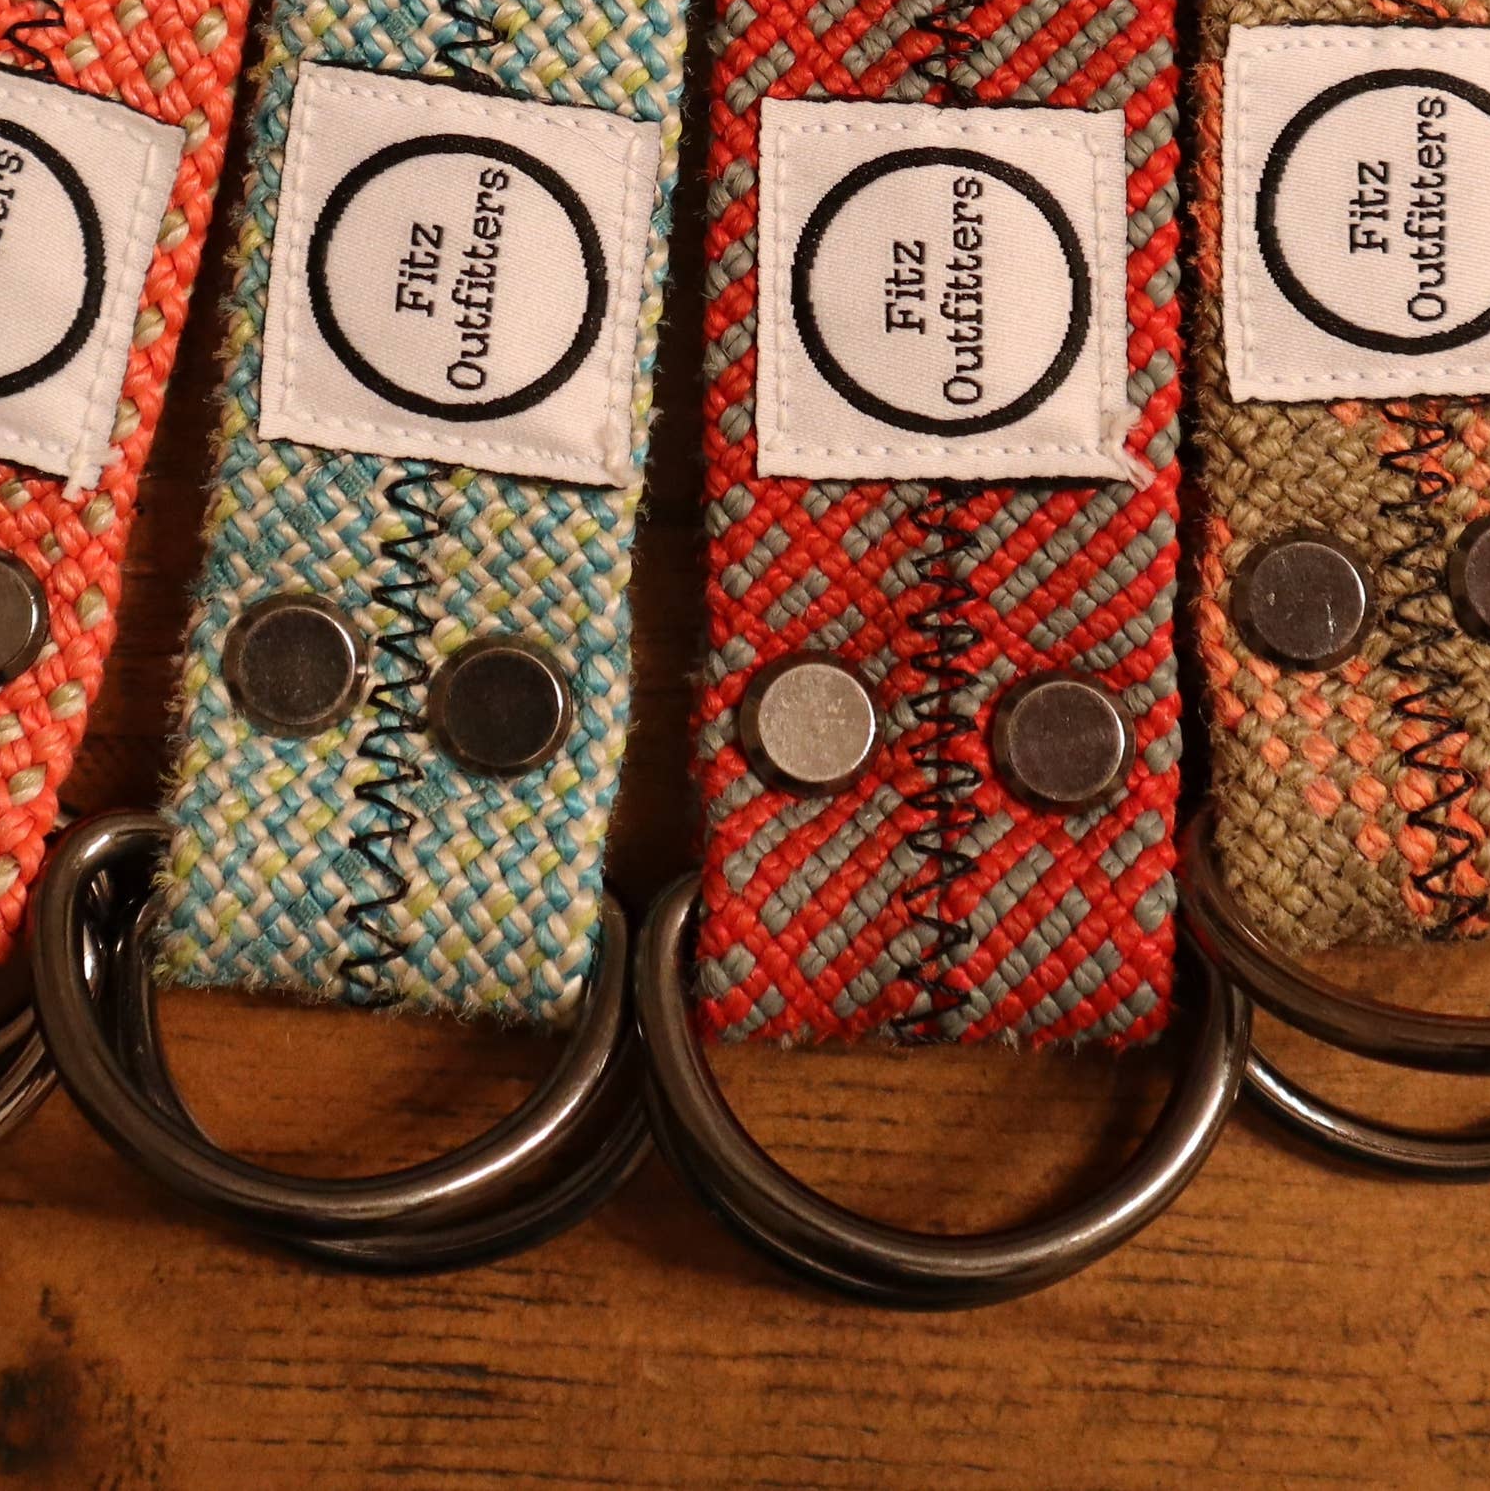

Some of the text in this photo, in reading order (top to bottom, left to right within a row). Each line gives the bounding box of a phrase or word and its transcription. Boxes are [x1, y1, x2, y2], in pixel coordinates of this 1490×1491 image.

[395, 223, 445, 317] Fitz
[446, 167, 512, 391] Outfitters
[1349, 160, 1390, 255] Fitz
[1404, 95, 1448, 322] Outfitters
[885, 240, 926, 335] Fitz
[940, 178, 983, 405] Outfitters
